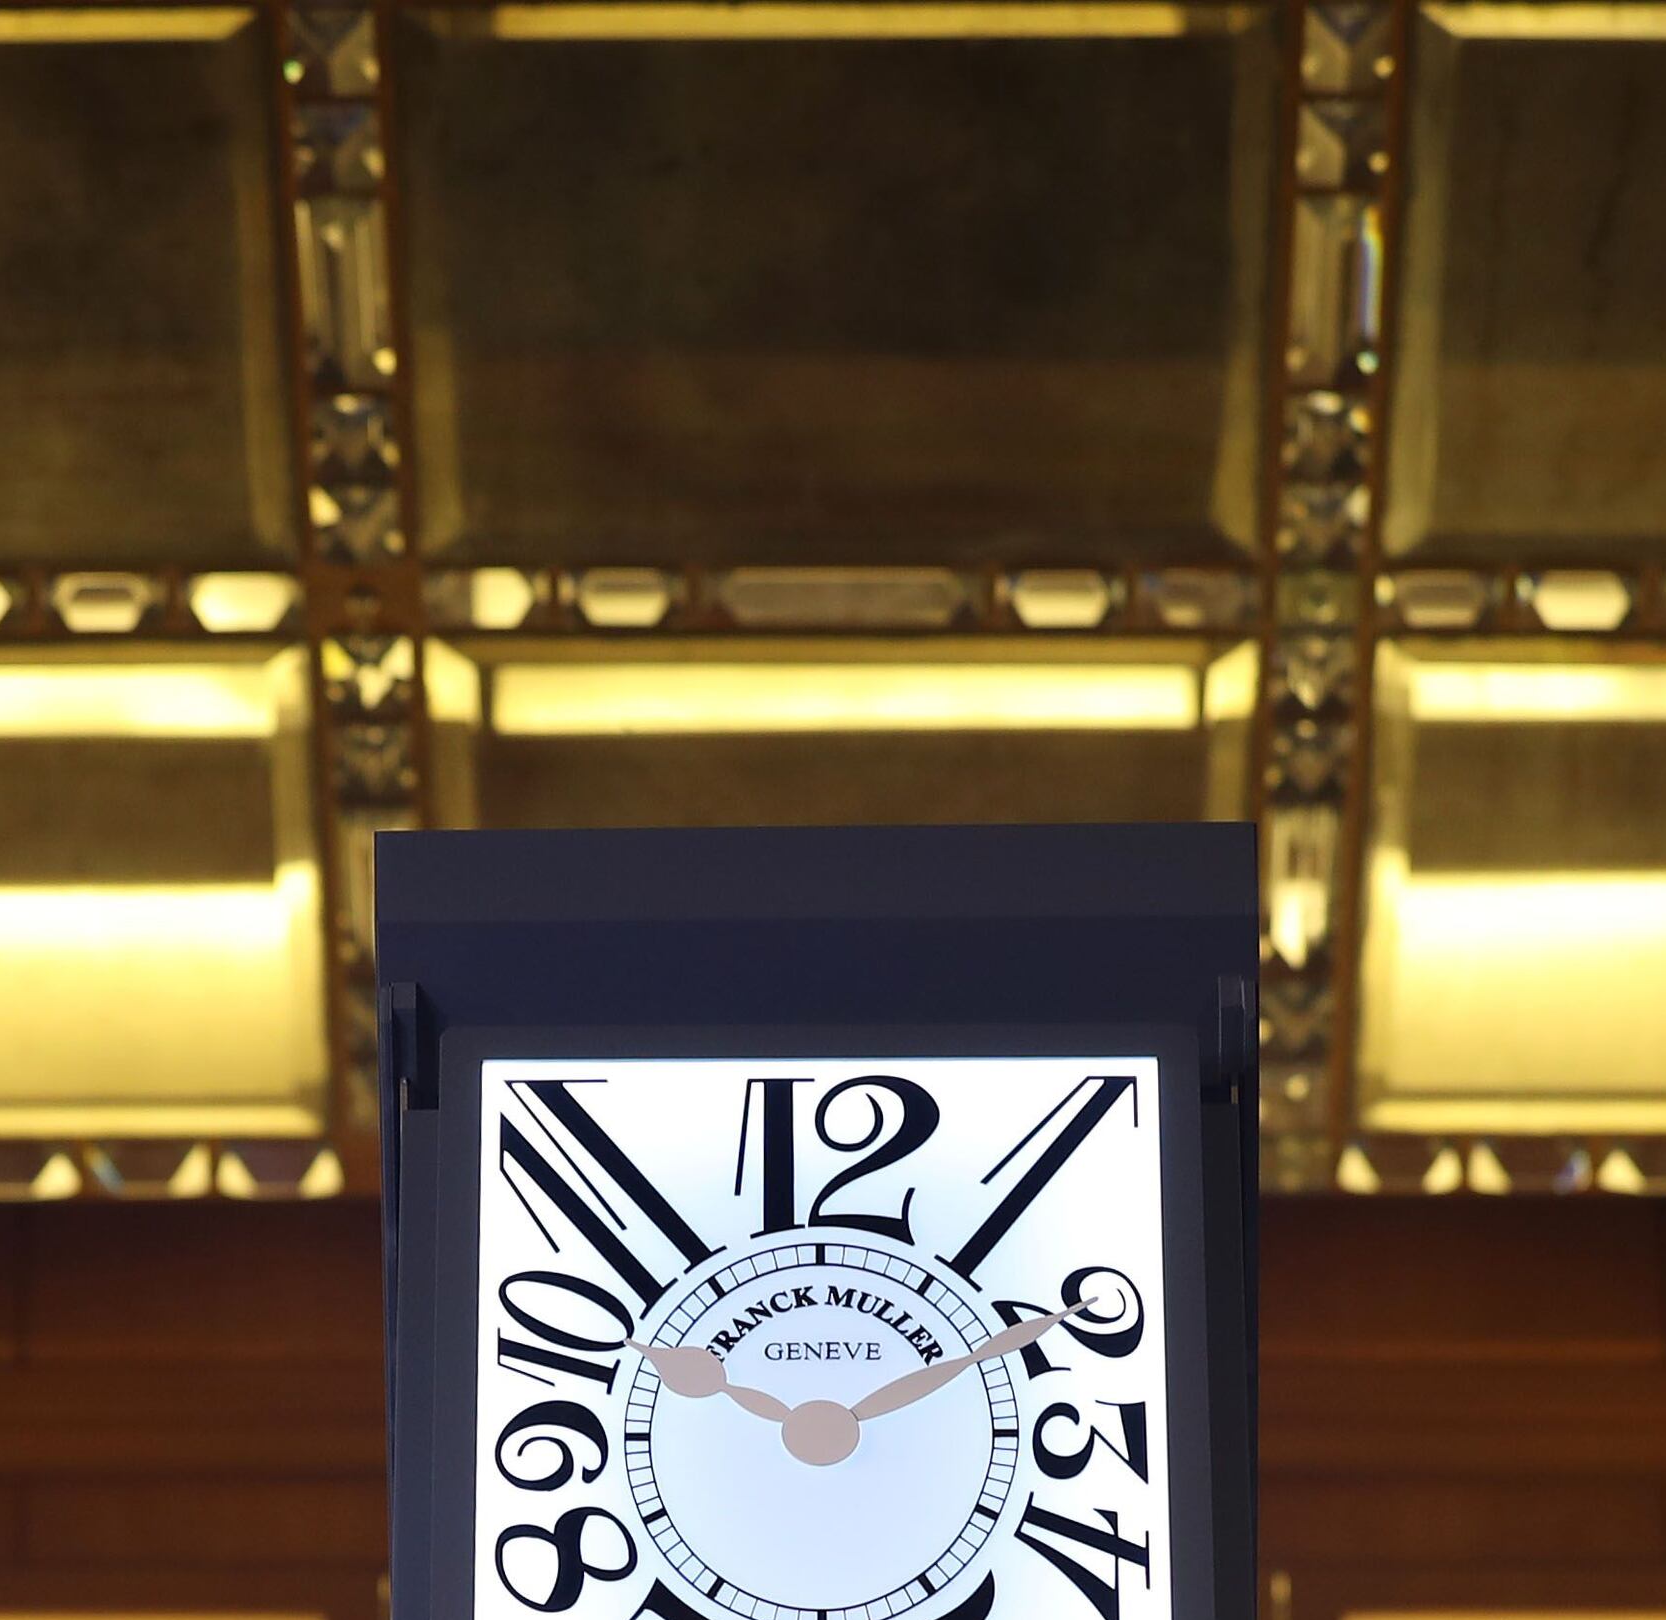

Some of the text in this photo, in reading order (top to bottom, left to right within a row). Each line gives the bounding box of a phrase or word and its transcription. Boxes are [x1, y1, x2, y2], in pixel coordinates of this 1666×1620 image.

[500, 1075, 727, 1320] 11
[735, 1075, 940, 1246] 12
[934, 1076, 1138, 1292] 1
[497, 1270, 635, 1395] 10
[764, 1342, 881, 1361] GENEVE
[825, 1285, 944, 1366] MULLER
[991, 1266, 1144, 1381] 2
[494, 1400, 609, 1492] 9
[1032, 1400, 1149, 1485] 3
[494, 1506, 638, 1613] 8
